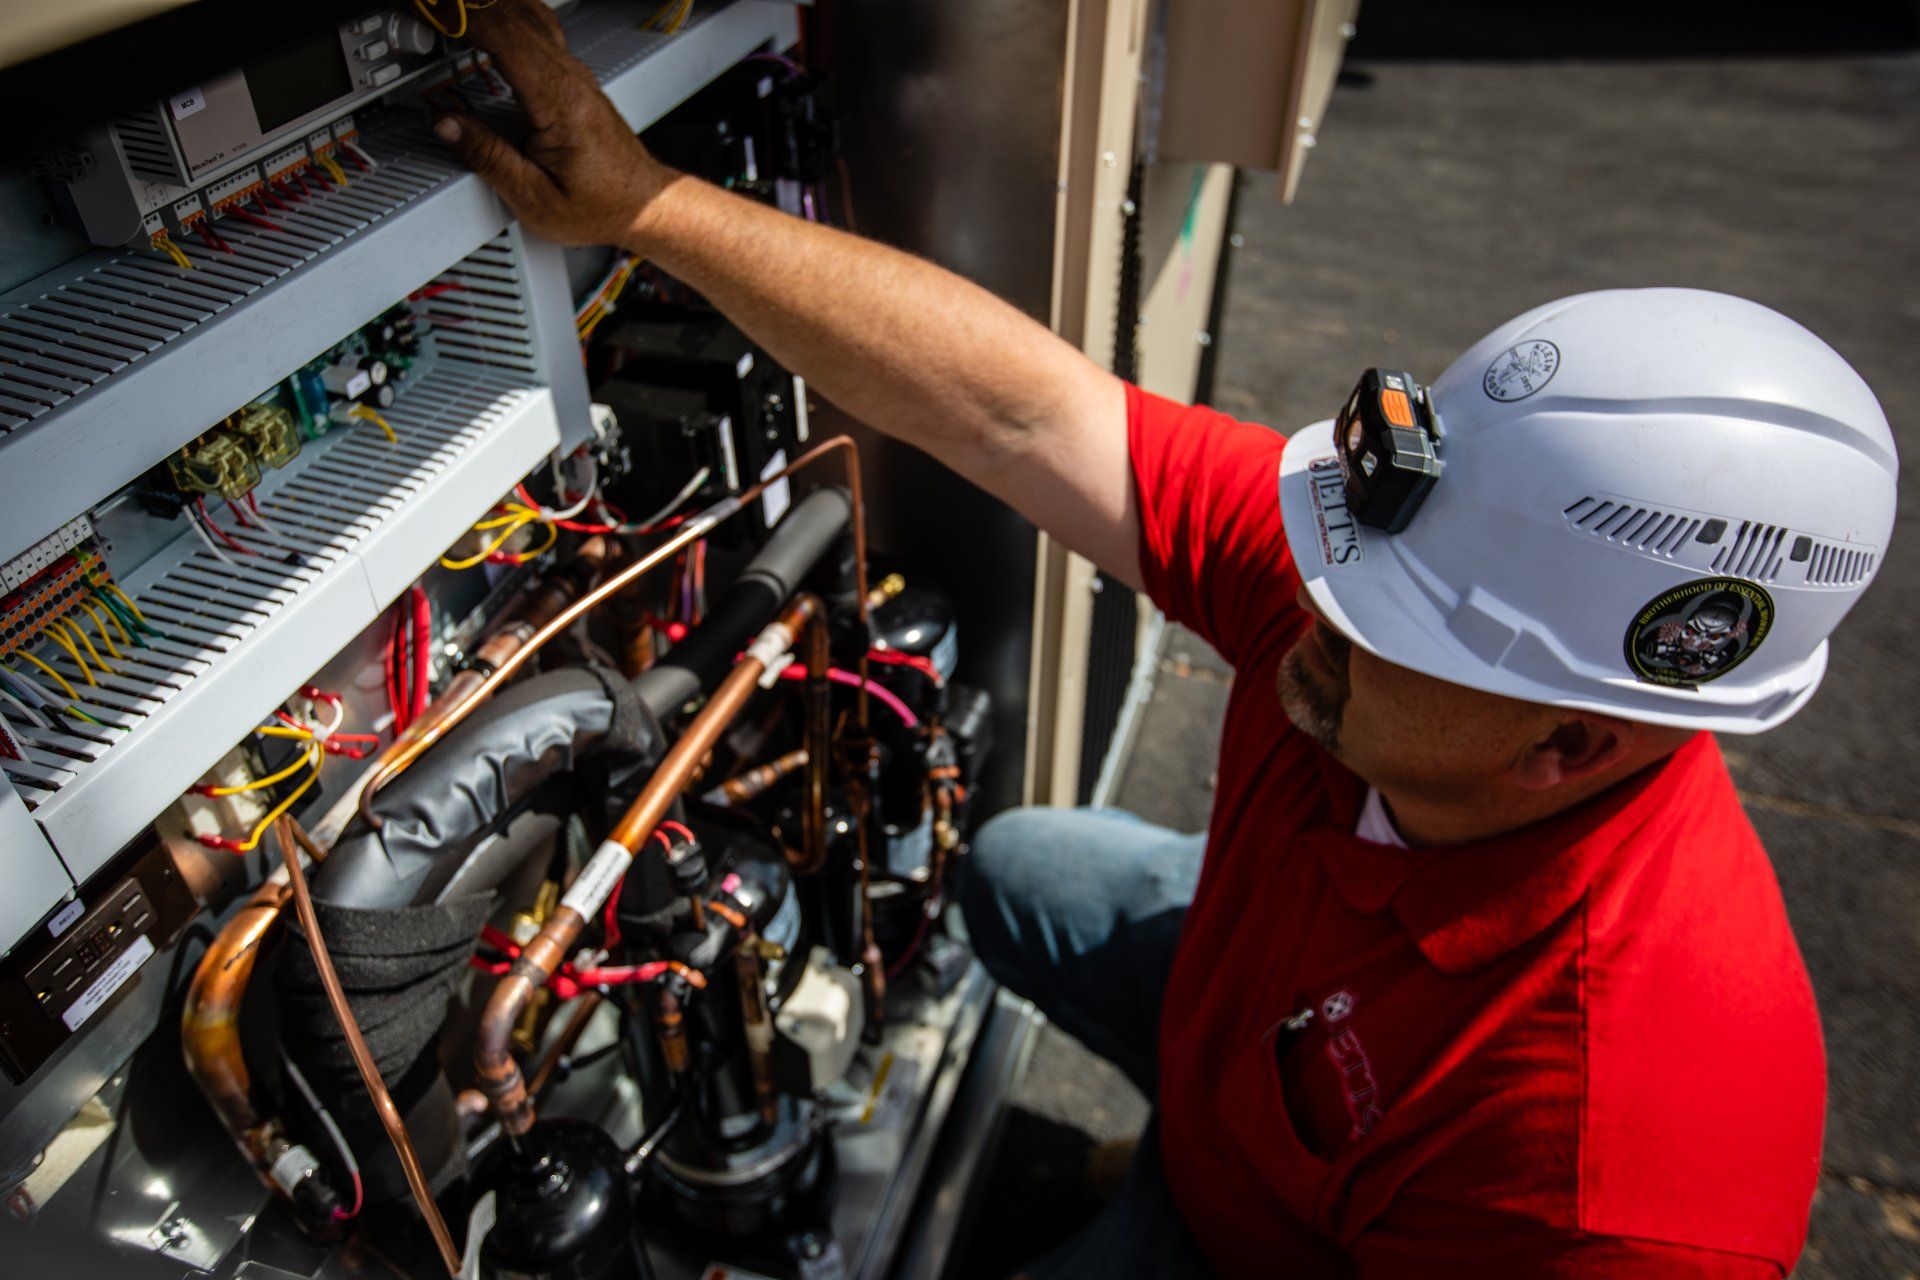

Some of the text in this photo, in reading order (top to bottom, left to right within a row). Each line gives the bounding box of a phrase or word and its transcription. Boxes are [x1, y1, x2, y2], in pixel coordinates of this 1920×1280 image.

[181, 98, 195, 110] MCB
[1533, 344, 1554, 373] KLEIN
[1488, 368, 1507, 397] TOOLS
[1311, 473, 1361, 565] JETT'S
[1317, 512, 1334, 565] CONTRACTING
[1639, 583, 1712, 625] BROTHERHOOD
[1714, 582, 1728, 591] OF
[1729, 583, 1766, 611] ESSENTIAL
